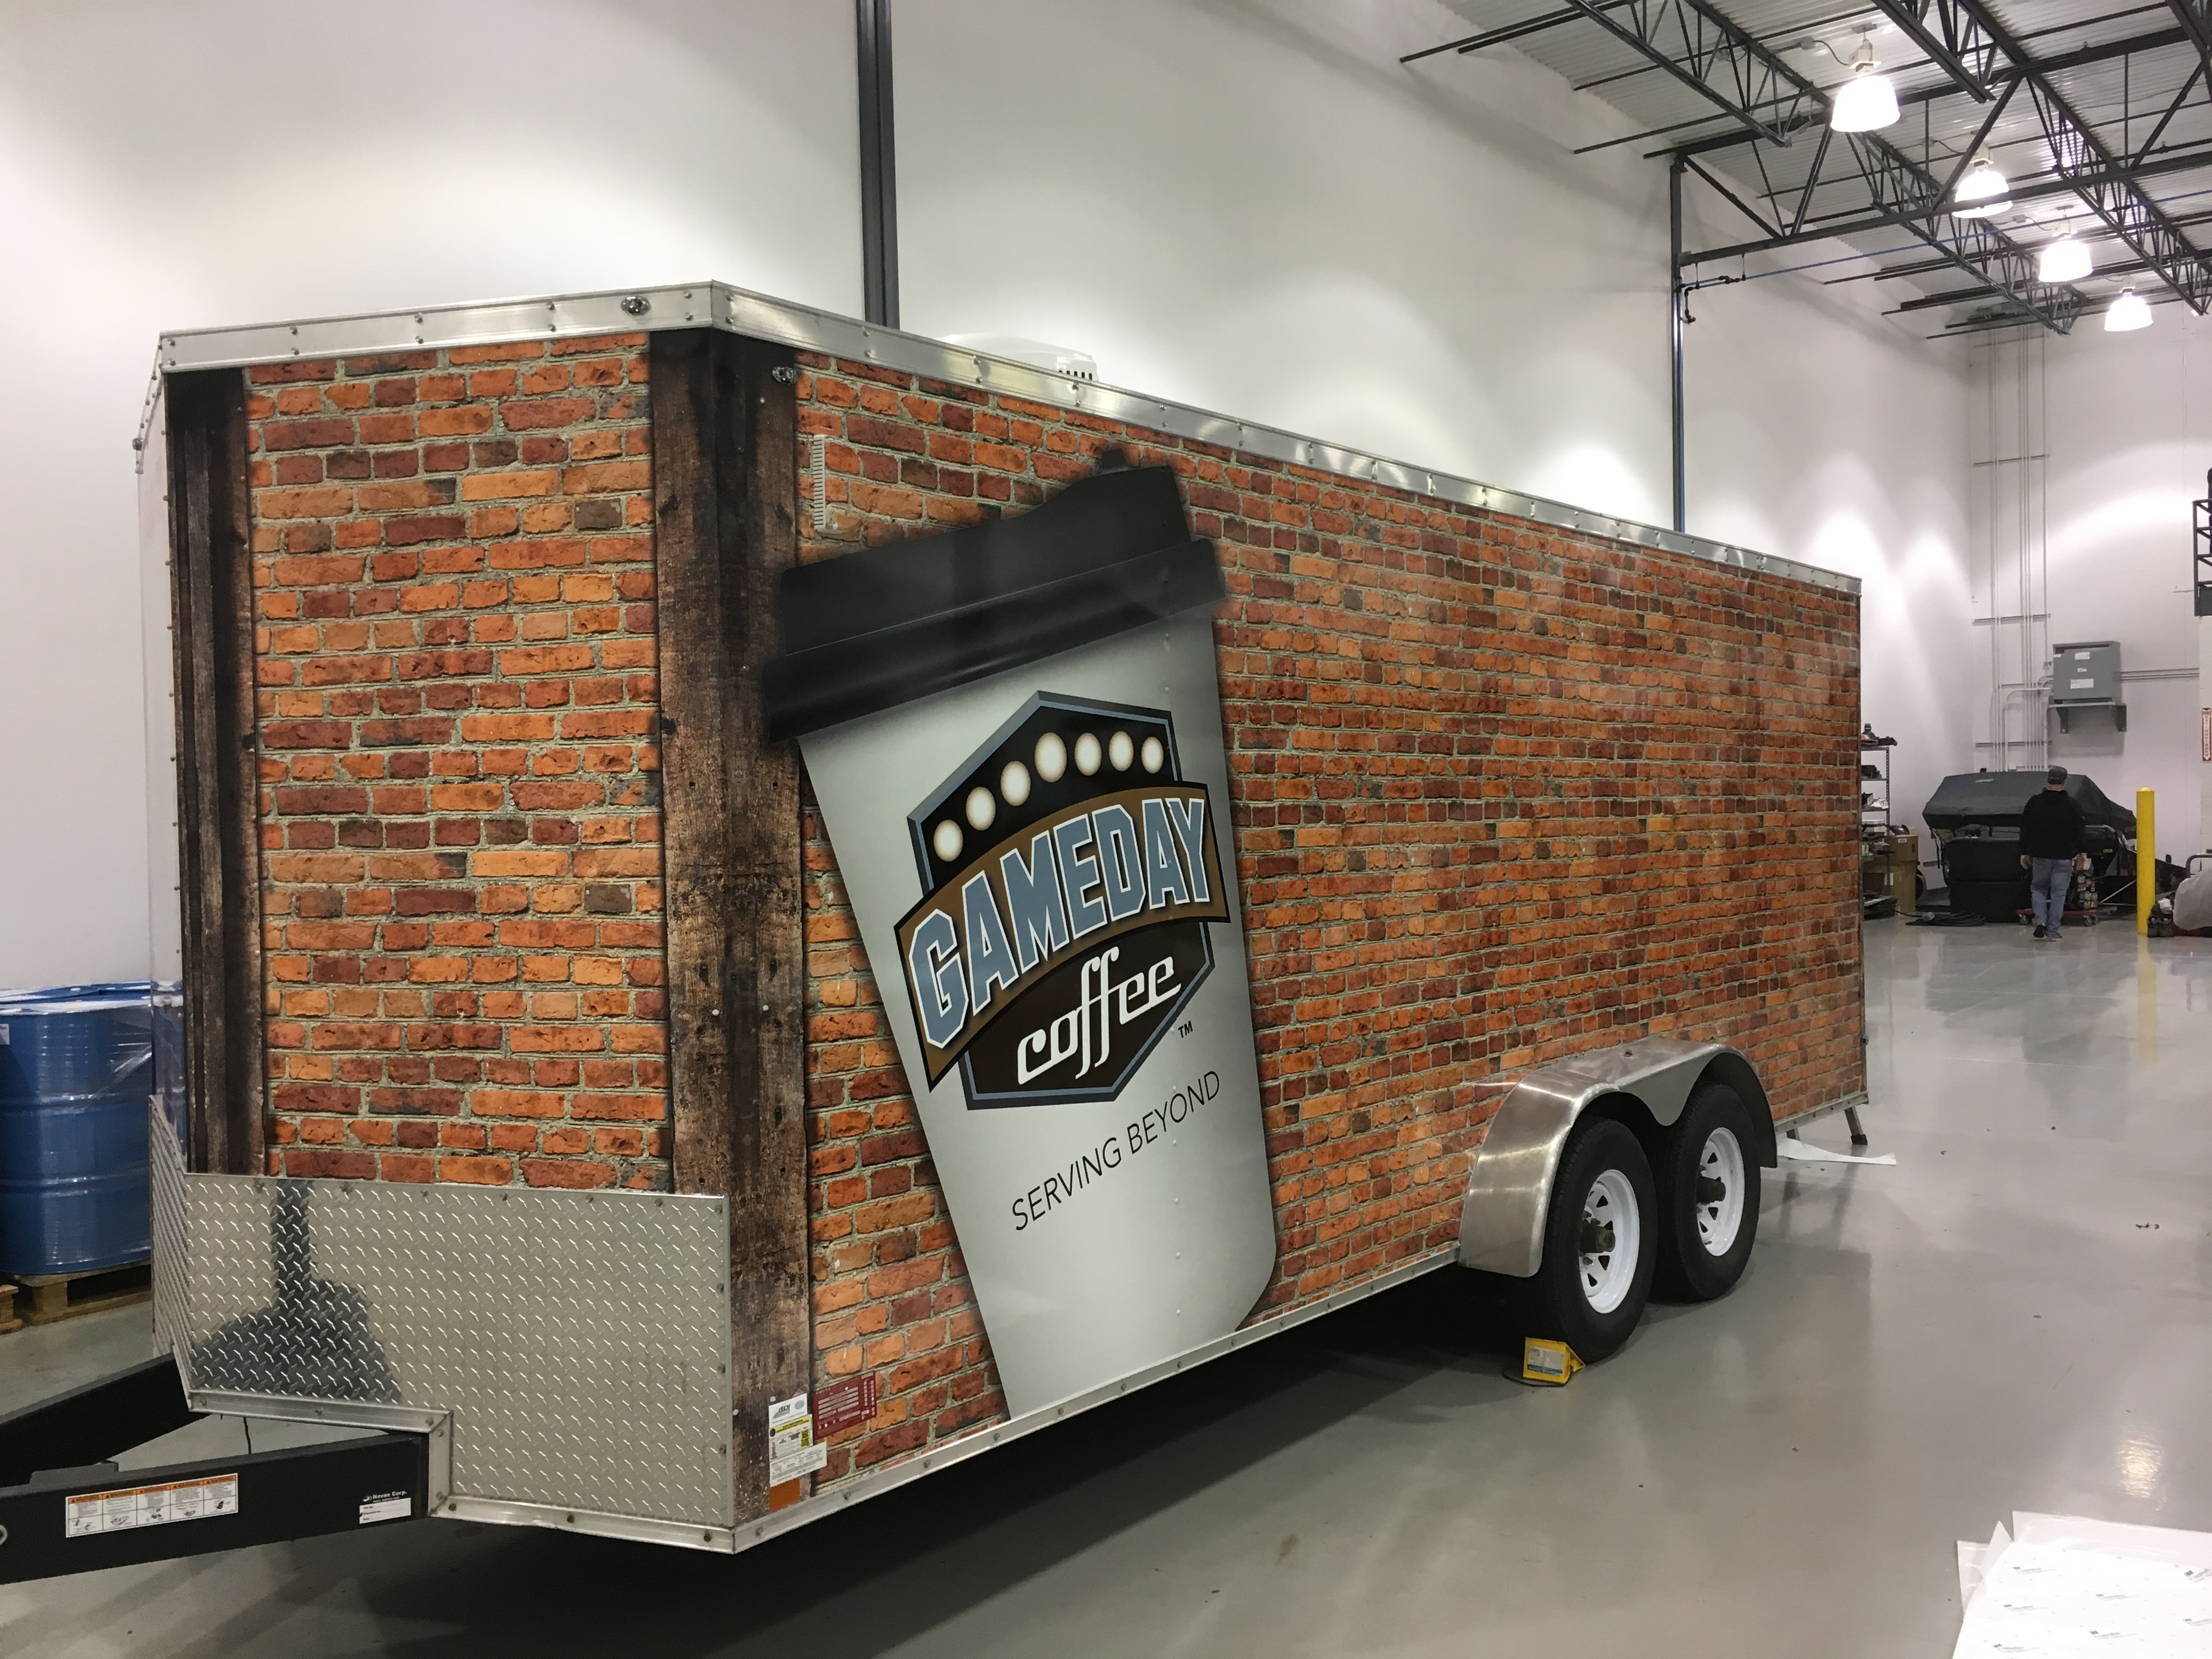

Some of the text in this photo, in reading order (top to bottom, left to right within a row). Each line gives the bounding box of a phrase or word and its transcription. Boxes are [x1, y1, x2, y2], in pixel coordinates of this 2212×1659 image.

[909, 797, 1210, 1048] GAMEDAY
[1017, 946, 1182, 1085] coffee
[1178, 1020, 1194, 1039] TM
[1012, 1071, 1220, 1231] SERVING BEYOND
